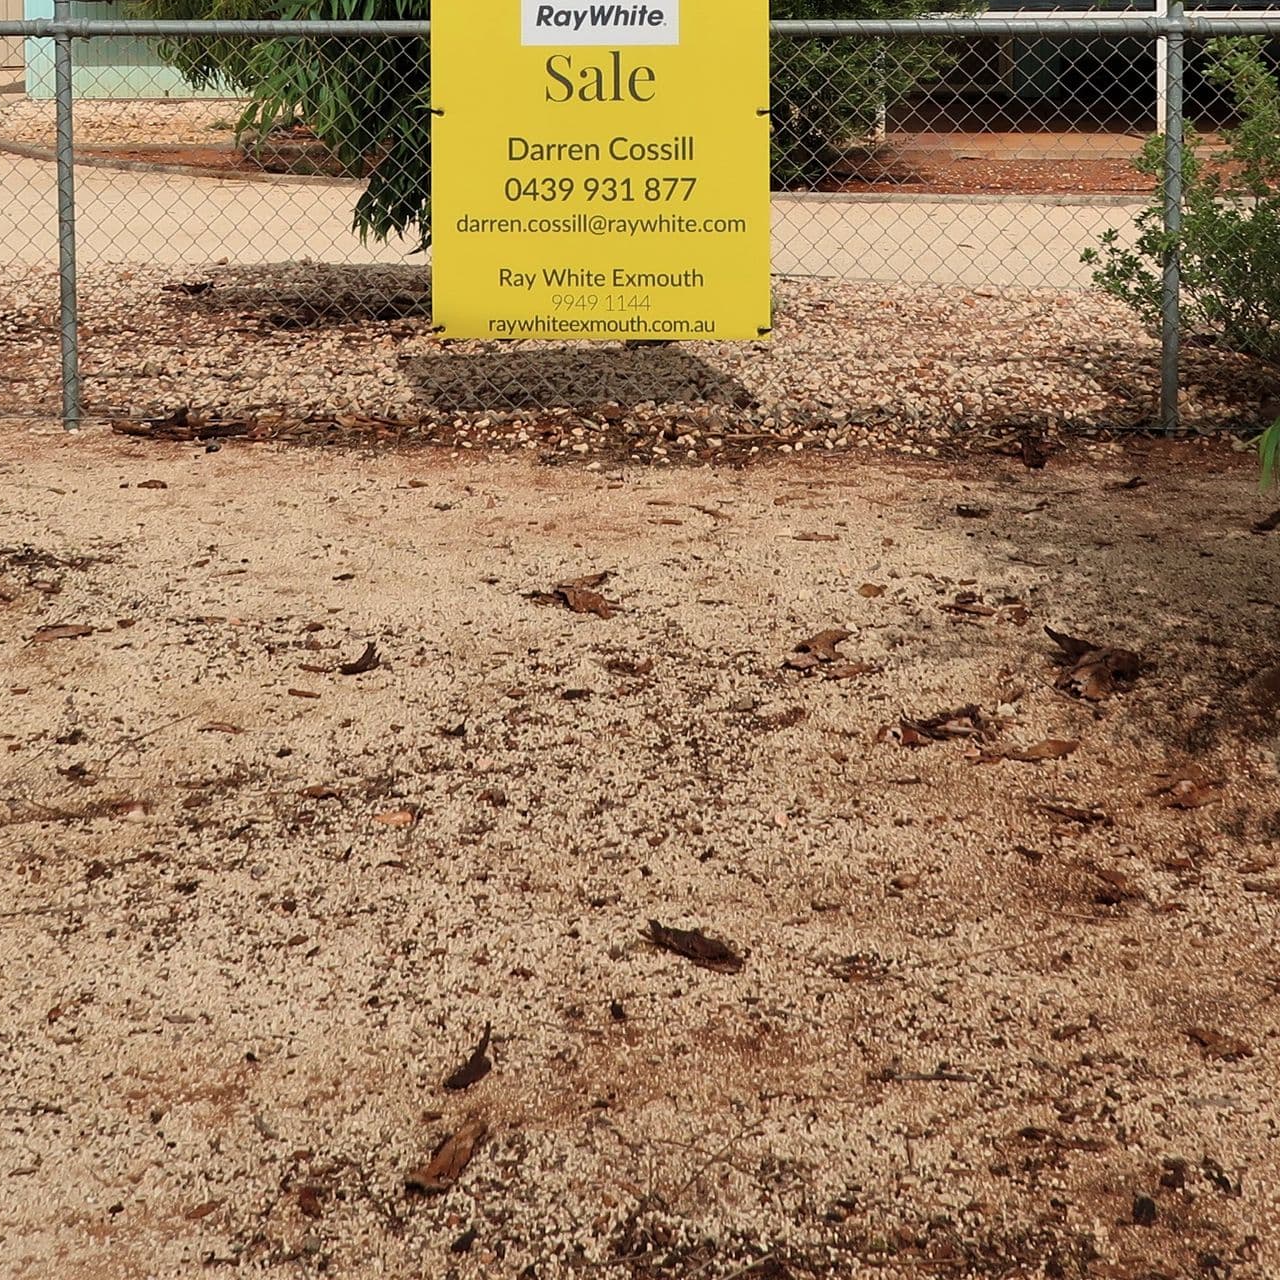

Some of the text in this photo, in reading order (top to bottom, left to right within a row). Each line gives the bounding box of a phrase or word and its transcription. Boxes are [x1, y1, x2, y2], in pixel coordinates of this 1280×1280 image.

[545, 51, 656, 103] Sale
[508, 136, 695, 161] Darren Cossill
[504, 177, 697, 202] 0439 931 877
[456, 214, 746, 235] darren.cossill@raywhite.com
[499, 268, 704, 290] Ray White Exmouth
[551, 294, 651, 311] 9949 1144
[488, 315, 715, 334] raywhiteexmouth.com.au
